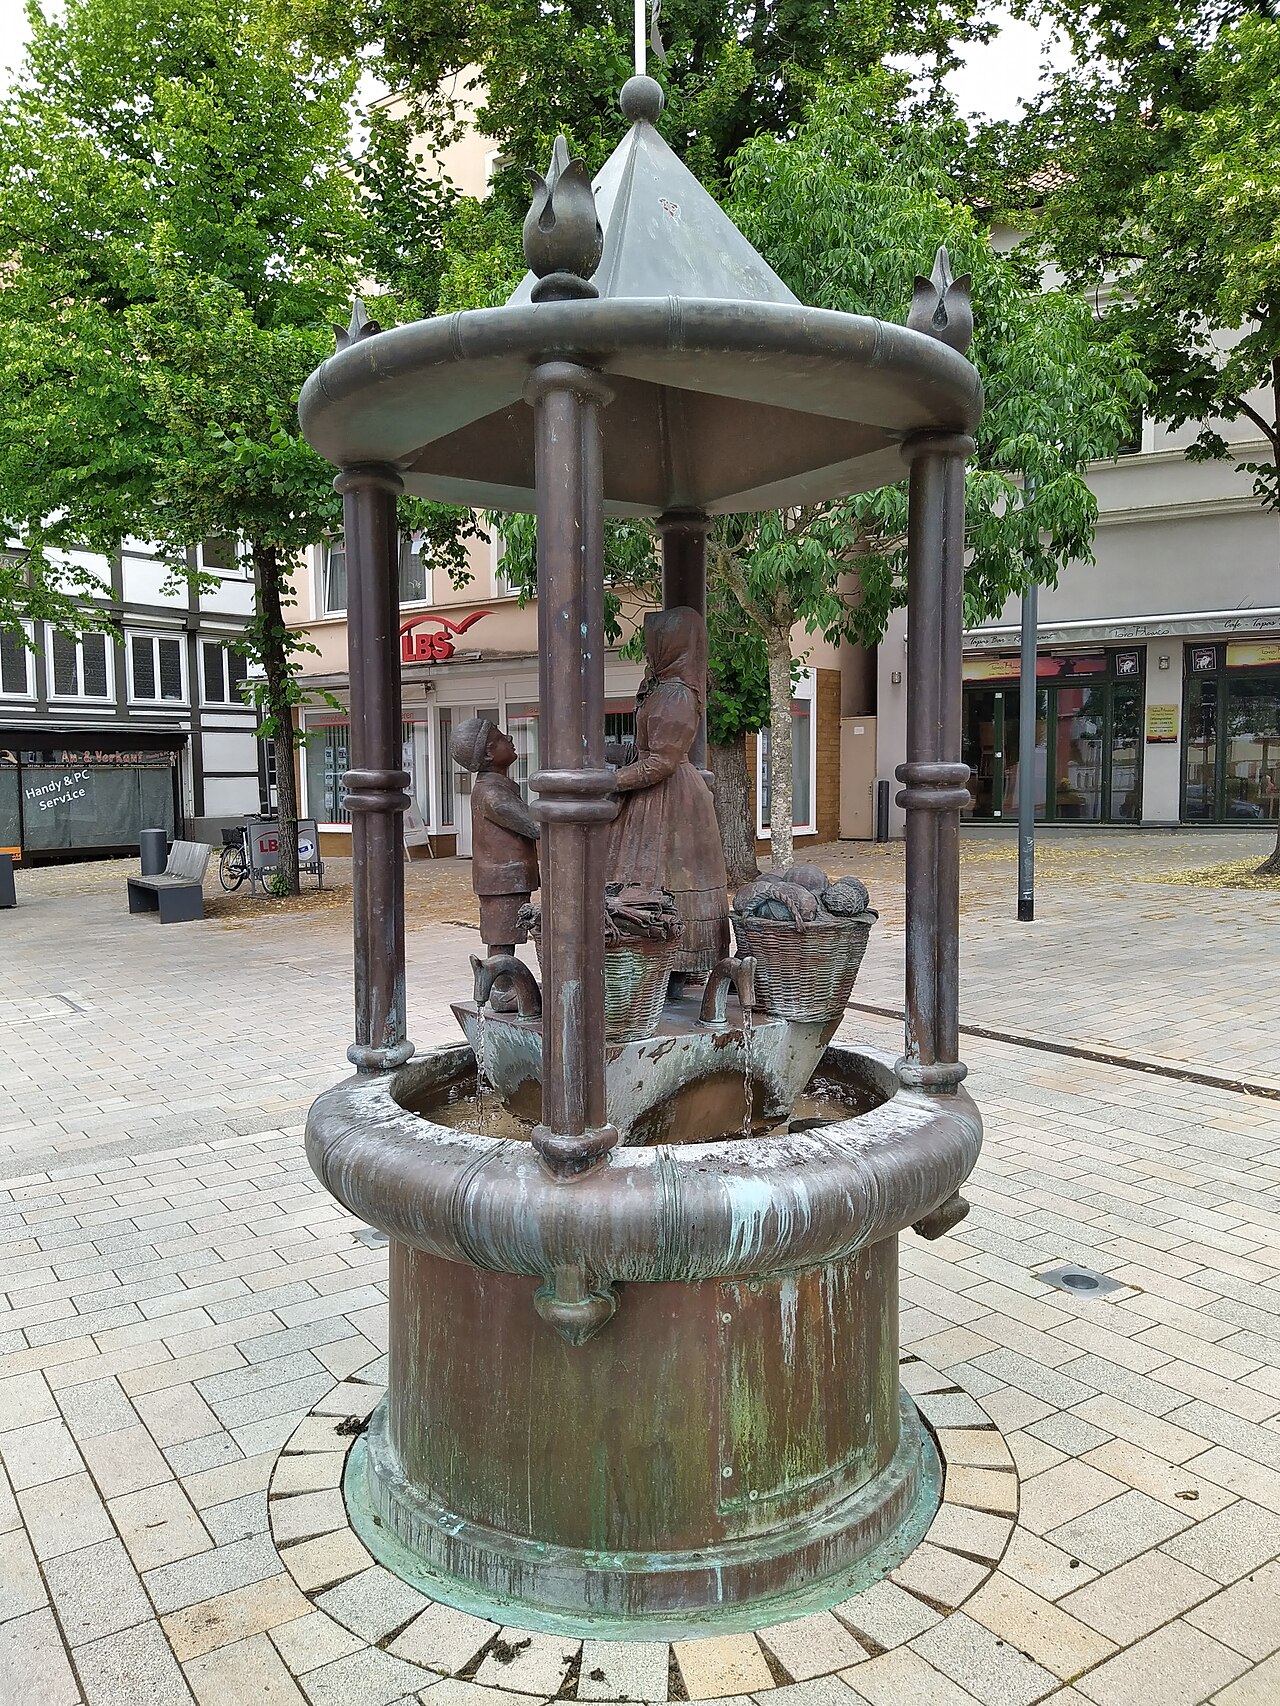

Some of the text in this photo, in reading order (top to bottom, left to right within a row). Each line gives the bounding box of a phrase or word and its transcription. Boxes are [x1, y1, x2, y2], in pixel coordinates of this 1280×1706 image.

[1253, 618, 1276, 629] Tapas
[1109, 625, 1169, 638] Toro Blanco
[402, 631, 456, 662] LBS
[970, 636, 989, 647] Tapas
[95, 750, 143, 763] Verkauf
[25, 769, 90, 799] Handy & PC
[39, 788, 86, 810] Service
[259, 839, 279, 853] LB
